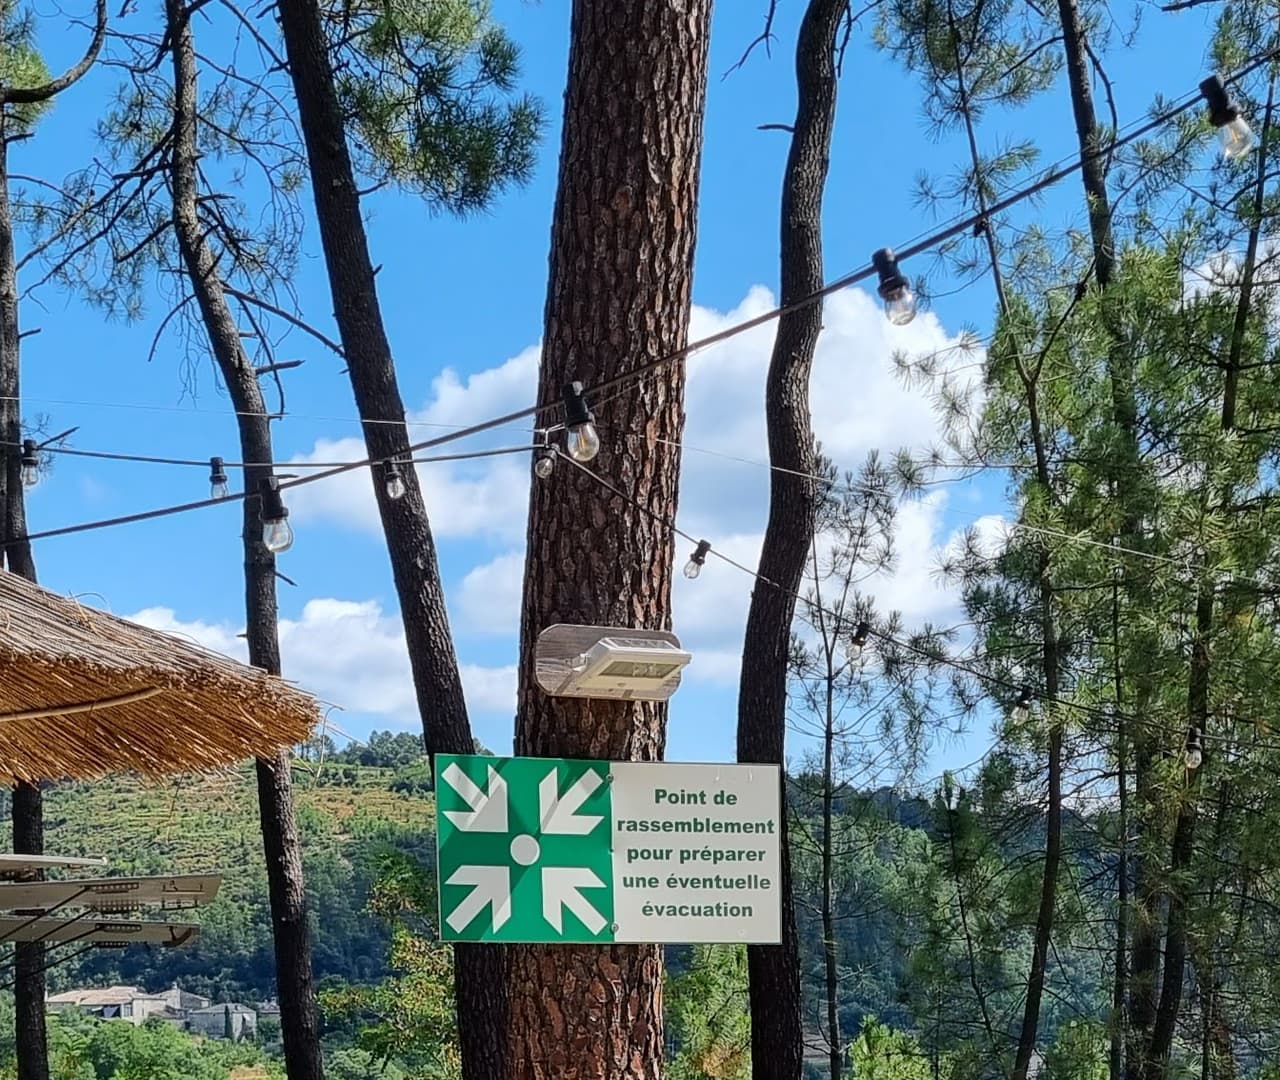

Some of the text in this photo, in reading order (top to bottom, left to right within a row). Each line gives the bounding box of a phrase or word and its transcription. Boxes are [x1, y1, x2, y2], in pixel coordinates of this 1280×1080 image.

[654, 788, 738, 806] Point de
[617, 817, 775, 833] rassemblement
[627, 845, 766, 865] pour préparer
[622, 873, 771, 890] une éventuelle
[641, 902, 754, 918] évacuation
